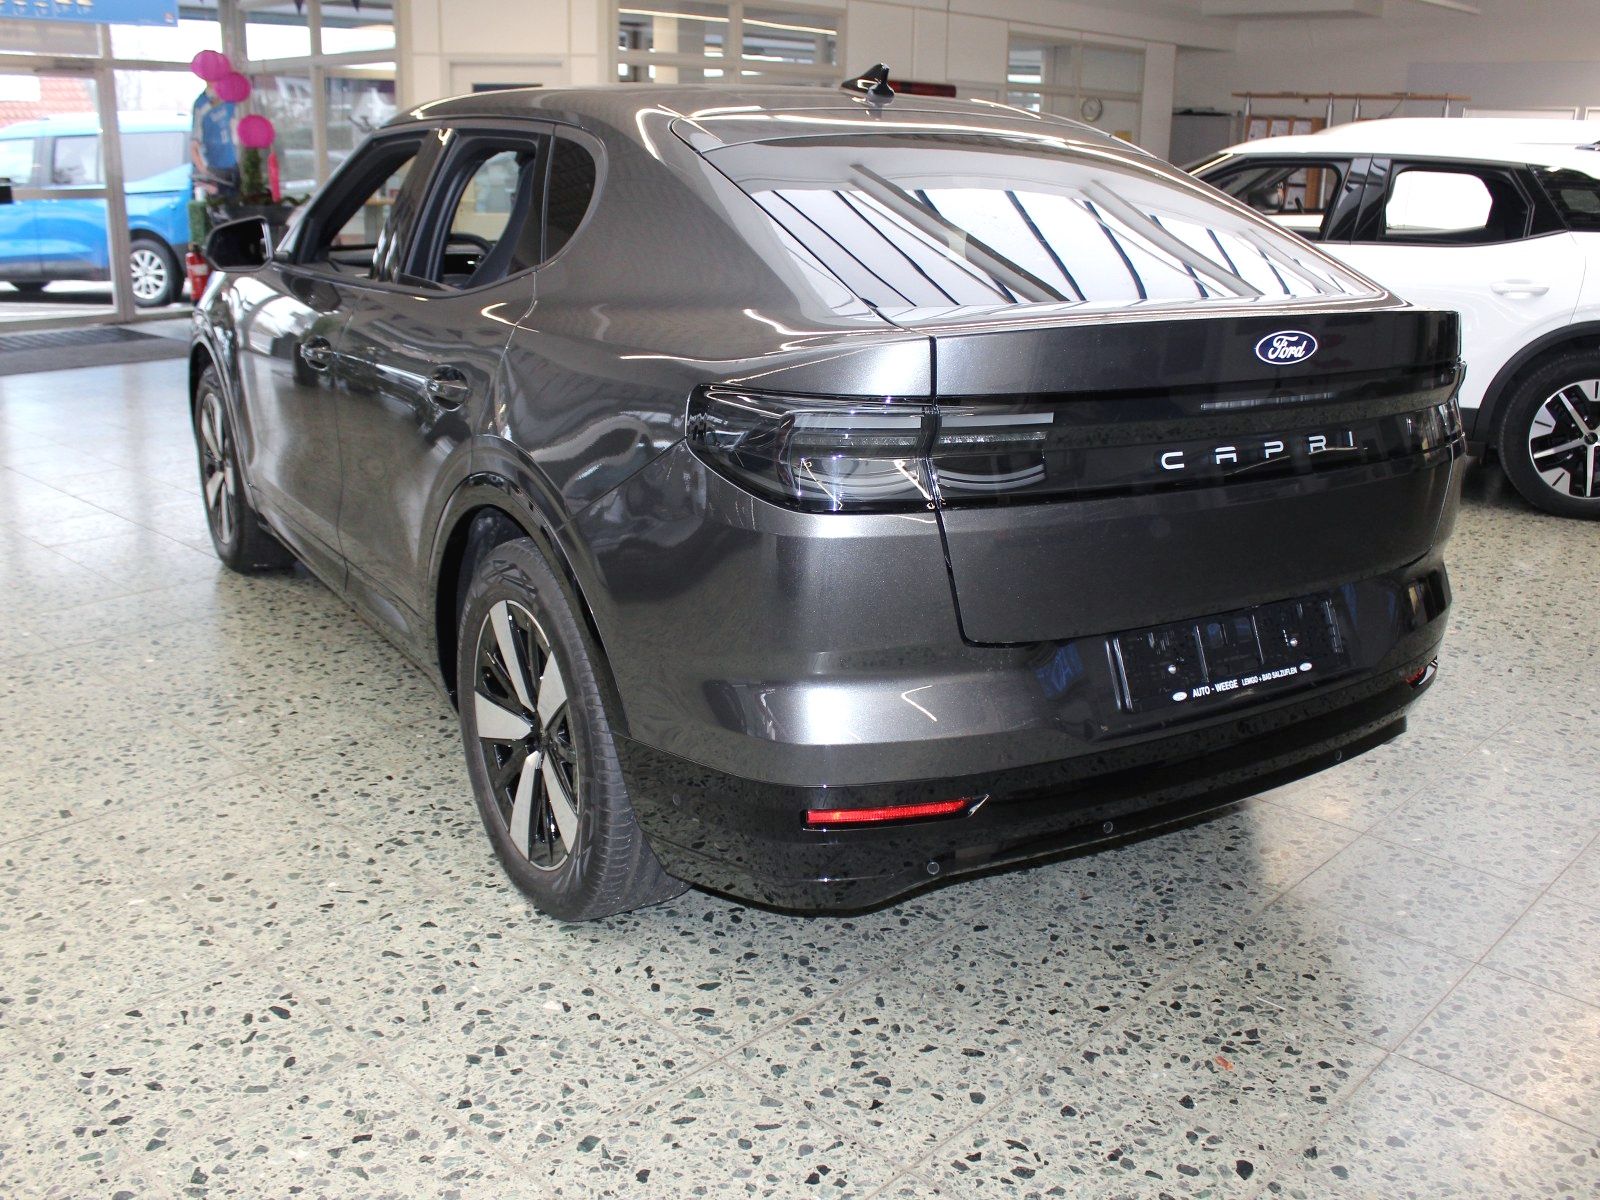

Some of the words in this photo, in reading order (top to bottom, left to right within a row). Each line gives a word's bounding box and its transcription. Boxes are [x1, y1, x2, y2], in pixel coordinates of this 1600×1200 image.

[1268, 335, 1307, 360] Ford
[1161, 431, 1354, 470] CAPRI
[1192, 686, 1211, 698] AUTO
[1214, 679, 1239, 692] WEEGE
